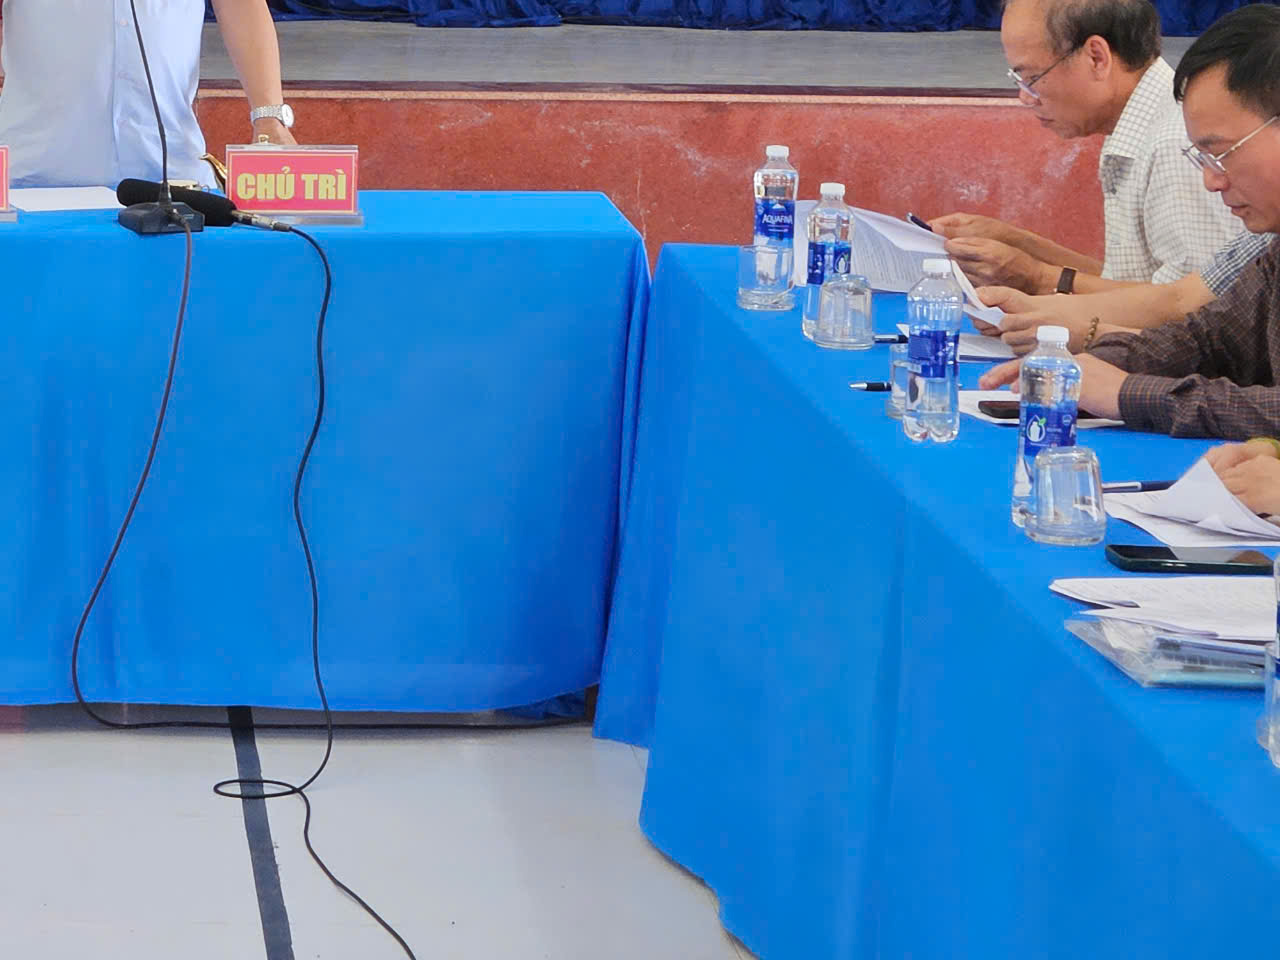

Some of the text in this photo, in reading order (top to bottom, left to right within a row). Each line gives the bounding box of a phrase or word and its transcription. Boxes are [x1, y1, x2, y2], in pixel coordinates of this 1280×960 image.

[236, 165, 347, 200] CHỦ TRÌ
[762, 214, 793, 224] AQUAFINA
